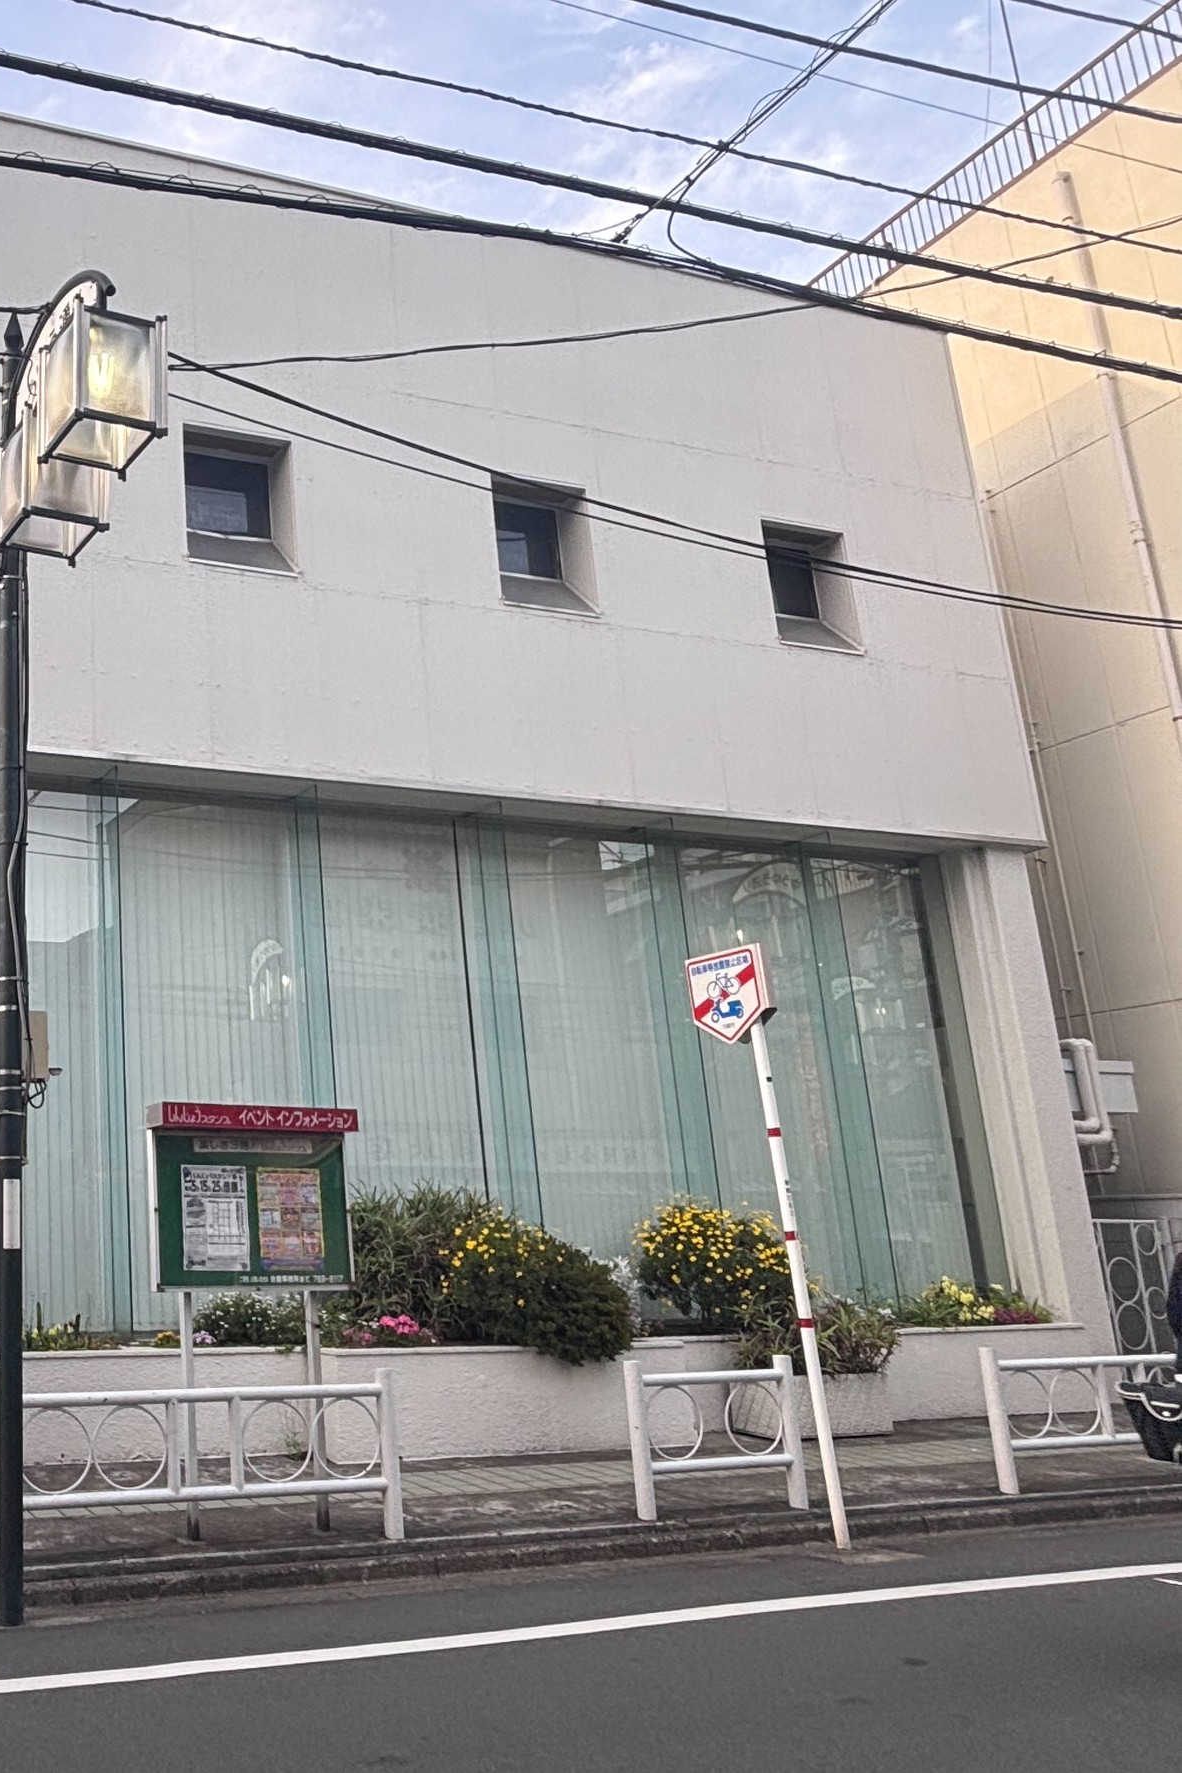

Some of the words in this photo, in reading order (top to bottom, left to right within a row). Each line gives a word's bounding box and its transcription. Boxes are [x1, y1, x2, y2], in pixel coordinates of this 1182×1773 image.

[239, 1108, 274, 1126] イベント
[276, 1110, 353, 1129] インフォメーション
